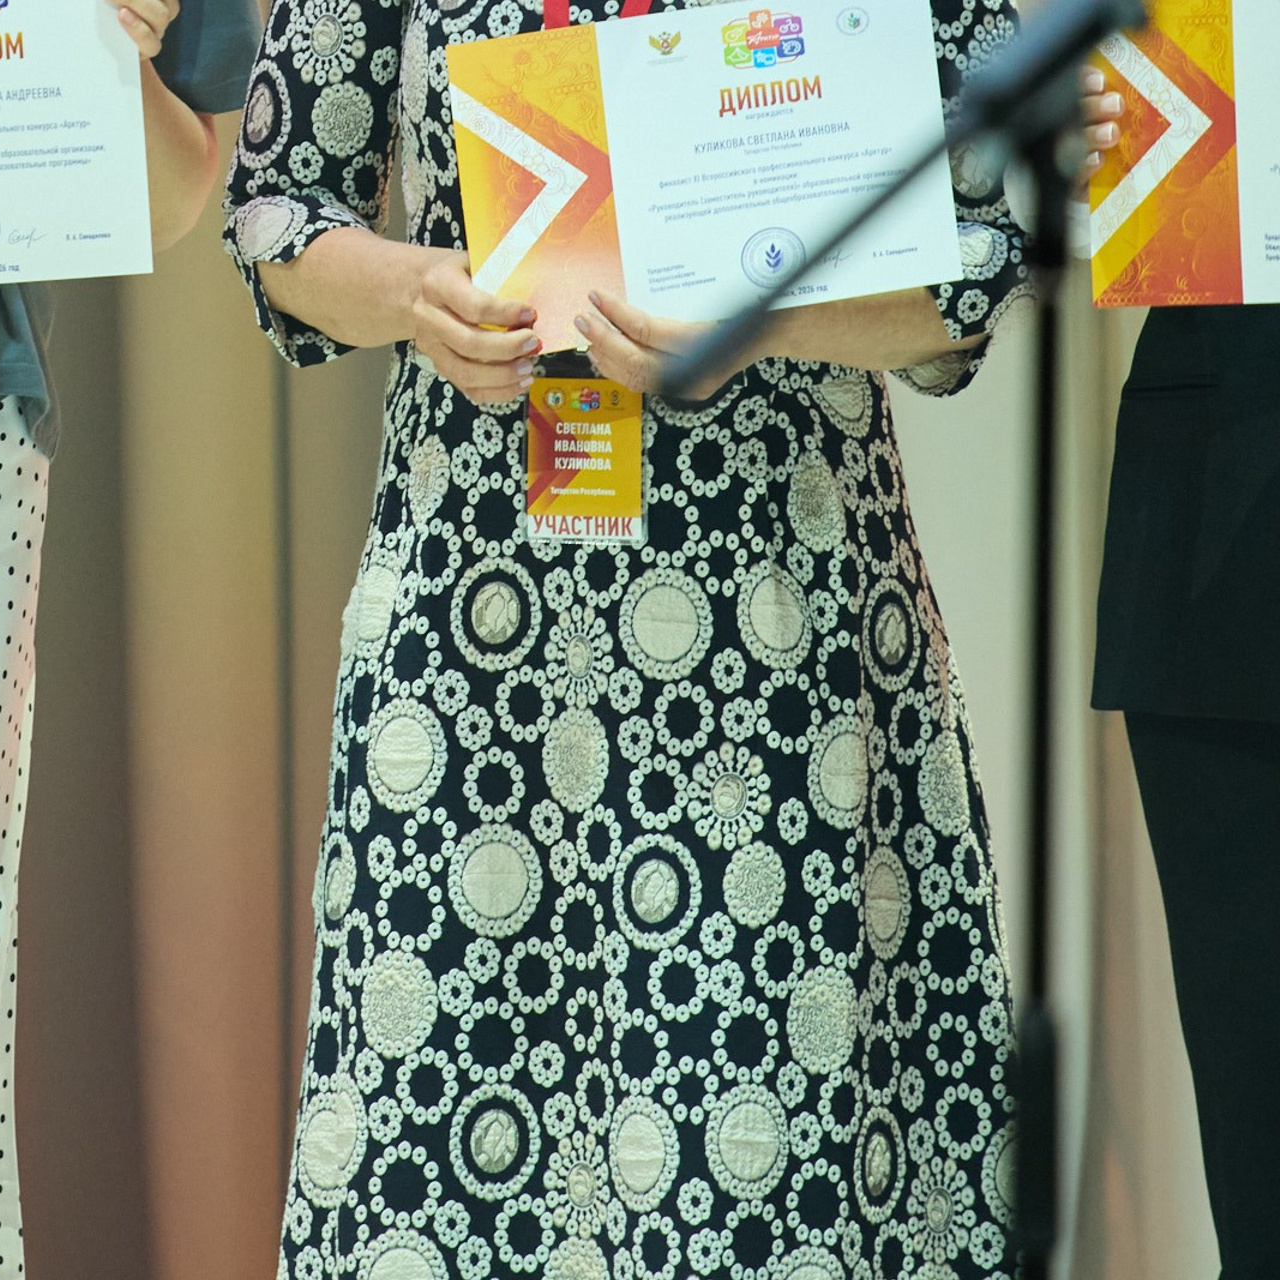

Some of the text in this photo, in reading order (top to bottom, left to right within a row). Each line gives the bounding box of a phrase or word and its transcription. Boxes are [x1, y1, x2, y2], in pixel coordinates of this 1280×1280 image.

[6, 85, 61, 102] АНДРЕЕВНА
[719, 74, 822, 117] ДИПЛОМ
[745, 107, 793, 120] награждается
[26, 122, 57, 131] конкурса
[694, 121, 850, 154] КУЛИКОВА СВЕТЛАНА ИВАНОВНА
[0, 146, 58, 158] образовательной
[659, 176, 690, 188] финалист
[701, 166, 755, 181] Всероссийского
[758, 156, 825, 173] профессионального
[827, 152, 858, 163] конкурса
[802, 173, 860, 189] образовательной
[665, 208, 711, 223] реализующей
[713, 199, 770, 214] дополнительные
[772, 187, 849, 205] общеобразовательные
[8, 264, 19, 272] год
[798, 284, 814, 294] 2026
[816, 283, 828, 293] год
[556, 422, 612, 436] СВЕТЛАНА
[554, 439, 613, 453] ИВАНОВНА
[554, 457, 612, 471] КУЛИКОВА
[533, 515, 633, 537] УЧАСТНИК
